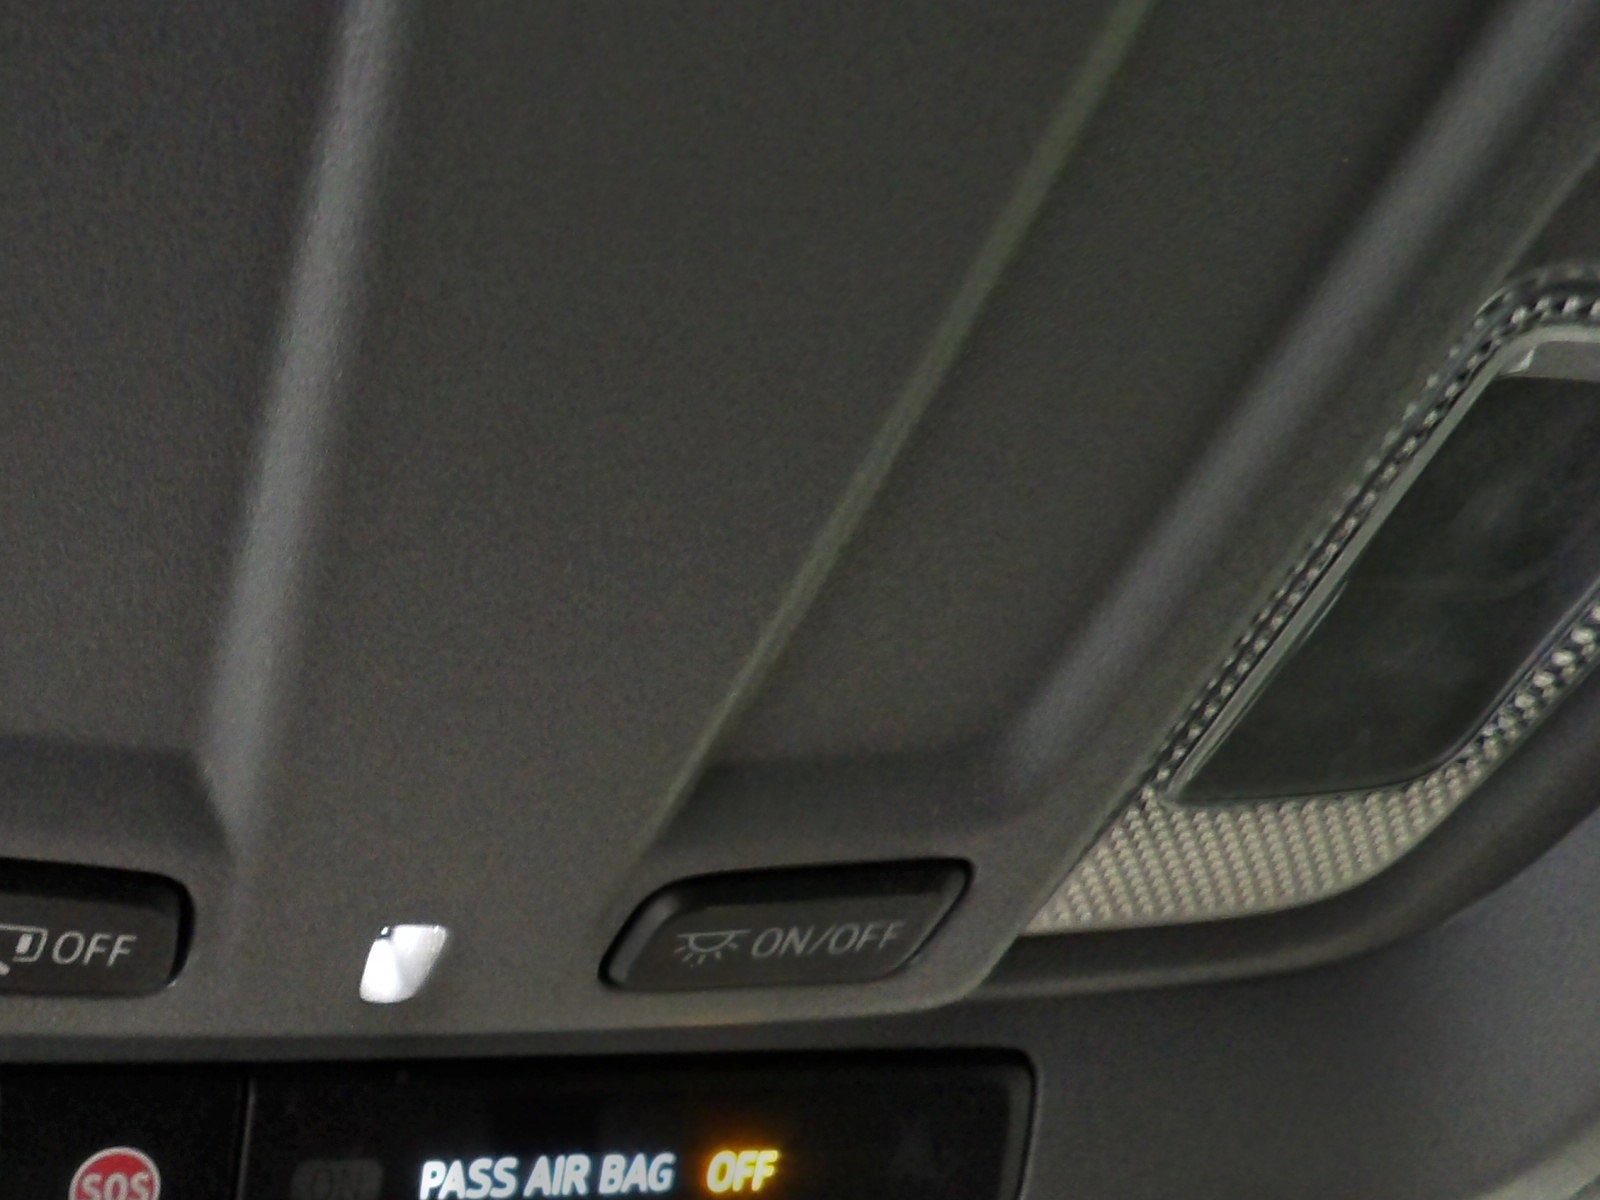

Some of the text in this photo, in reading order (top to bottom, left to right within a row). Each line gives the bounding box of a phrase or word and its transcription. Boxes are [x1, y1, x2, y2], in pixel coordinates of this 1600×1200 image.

[52, 930, 137, 966] OFF
[751, 920, 907, 959] ON/OFF
[419, 1150, 780, 1200] PASS AIR BAG OFF
